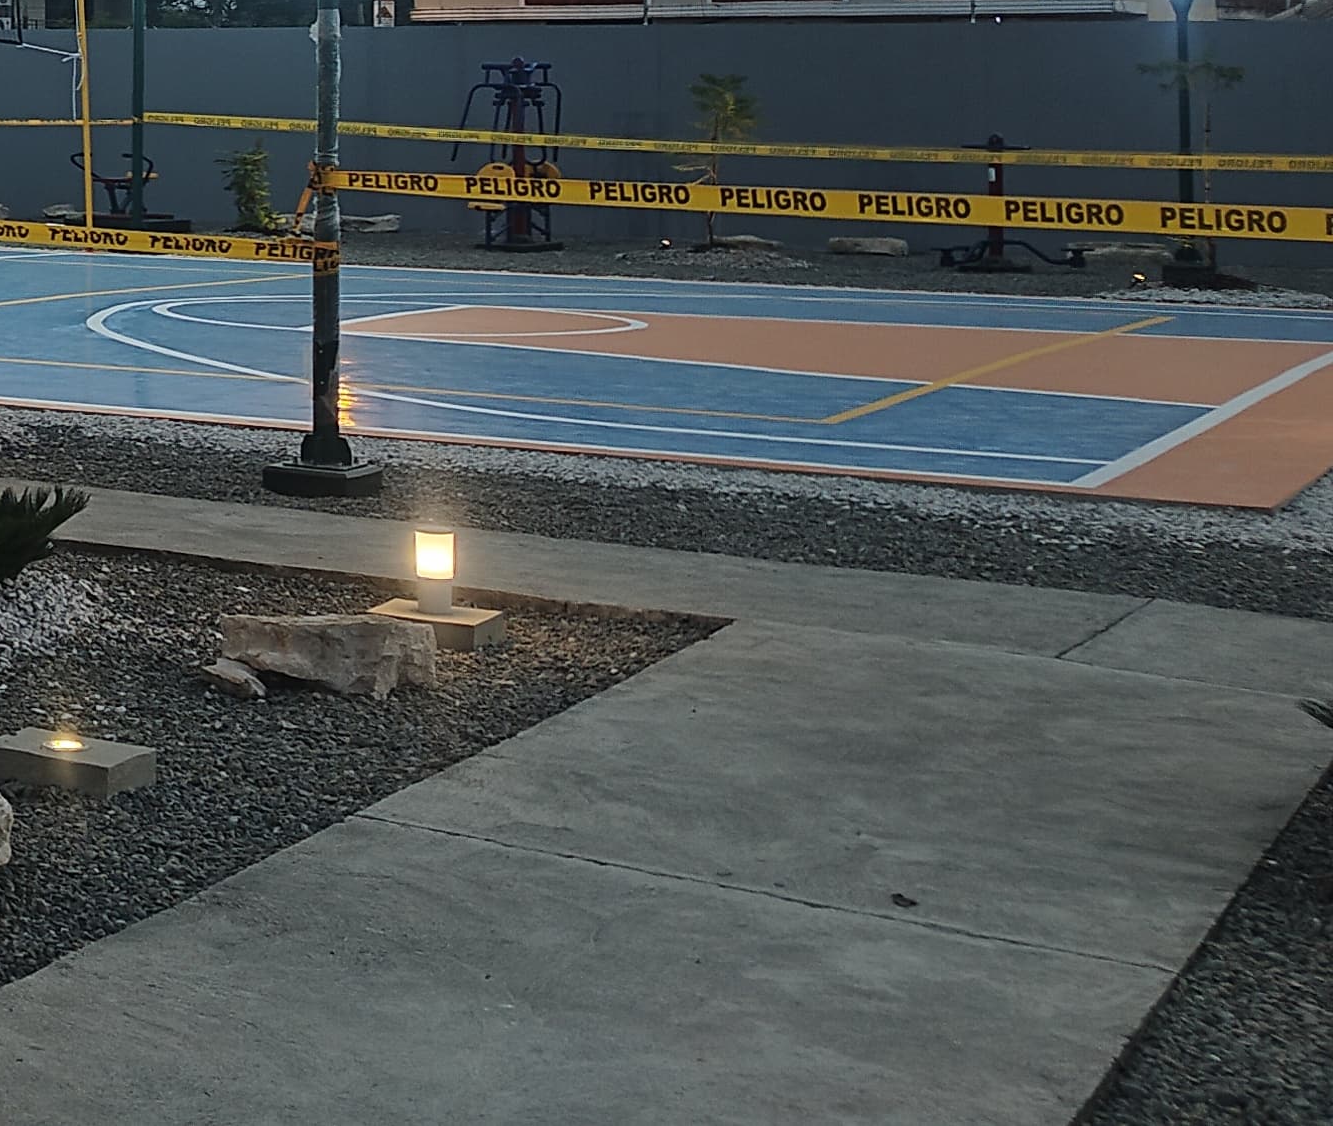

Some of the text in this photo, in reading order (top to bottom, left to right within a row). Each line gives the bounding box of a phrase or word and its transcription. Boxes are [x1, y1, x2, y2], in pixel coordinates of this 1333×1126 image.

[348, 172, 1287, 233] PELIGRO PELIGRO PELIGRO PELIGRO PELIGRO PELIGRO PELIGRO
